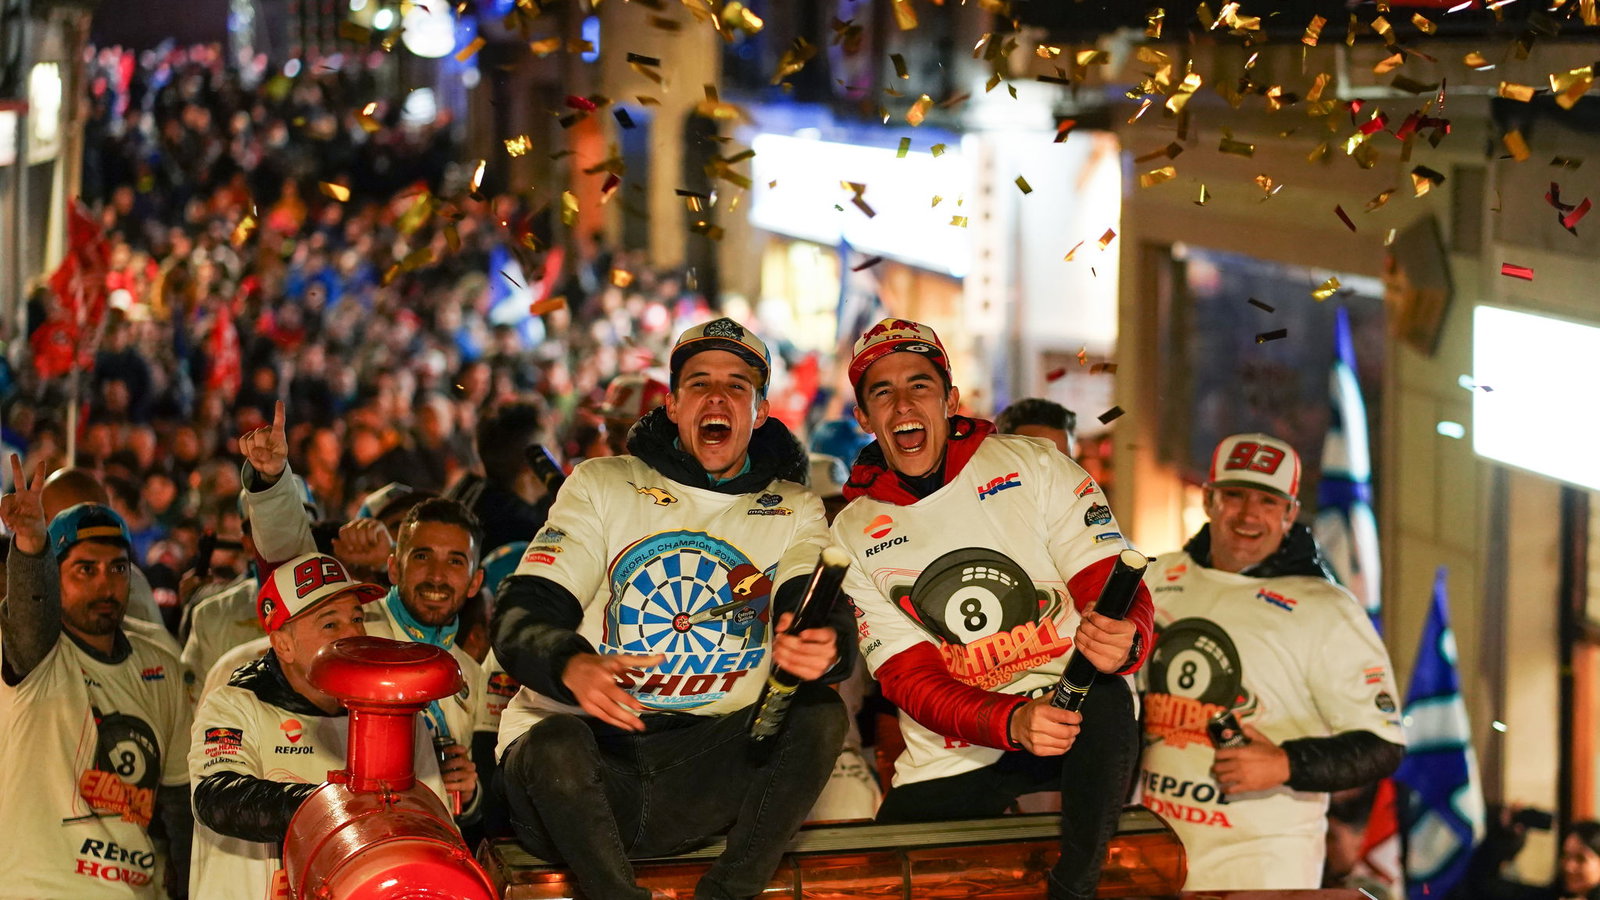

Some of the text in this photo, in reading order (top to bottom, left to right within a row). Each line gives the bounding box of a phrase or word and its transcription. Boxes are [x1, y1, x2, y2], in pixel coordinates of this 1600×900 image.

[1224, 442, 1285, 475] 93
[977, 472, 1022, 501] HRC
[620, 540, 736, 578] WORLD CHAMPION 2019
[865, 535, 909, 558] REPSOL
[294, 557, 348, 599] 93
[1256, 588, 1298, 612] HRC
[960, 598, 987, 632] 8
[940, 616, 1073, 677] EIGHTBALL
[980, 671, 1013, 690] 2019
[987, 654, 1052, 681] CHAMPION
[1178, 661, 1197, 688] 8
[613, 670, 749, 697] SHOT
[275, 746, 314, 754] REPSOL
[117, 751, 135, 777] 8
